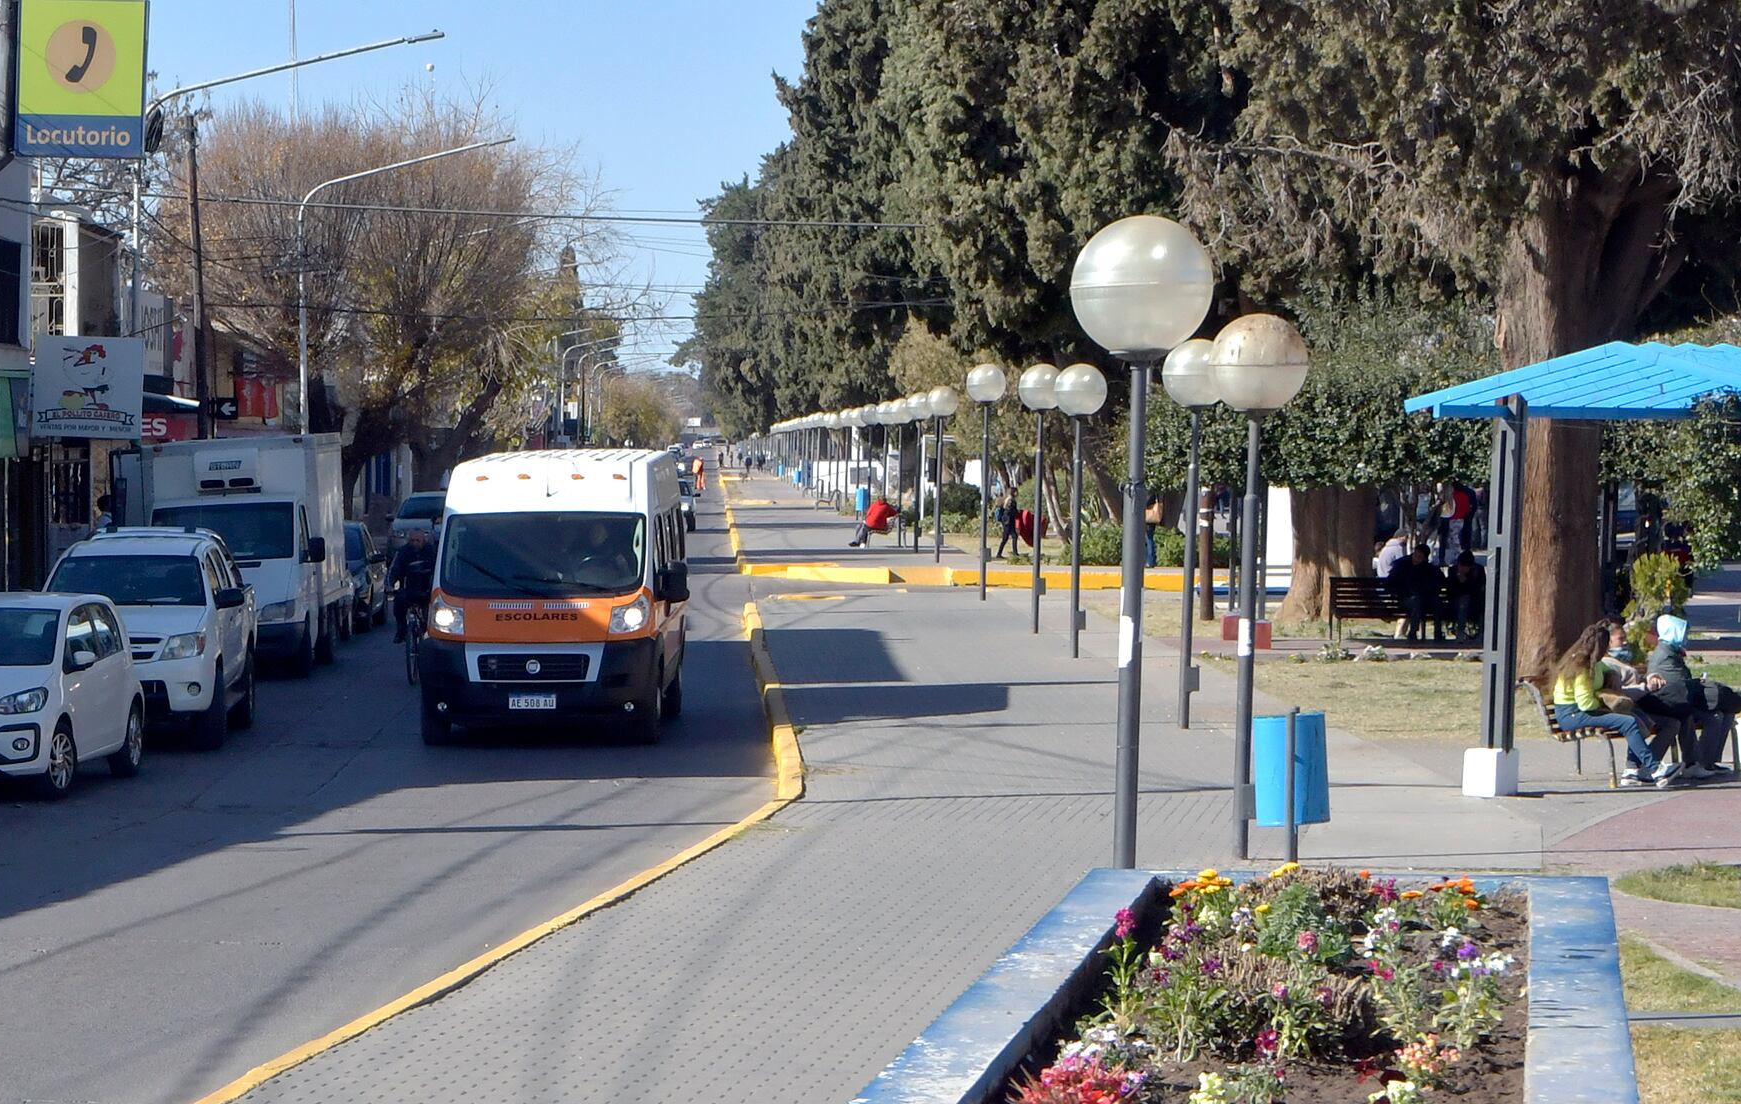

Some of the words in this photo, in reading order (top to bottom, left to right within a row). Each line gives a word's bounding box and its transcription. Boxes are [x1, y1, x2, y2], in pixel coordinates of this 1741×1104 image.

[26, 124, 130, 146] Locutorio
[62, 410, 93, 418] POLLITO
[495, 612, 578, 621] ESCOLARES
[511, 699, 522, 708] AE
